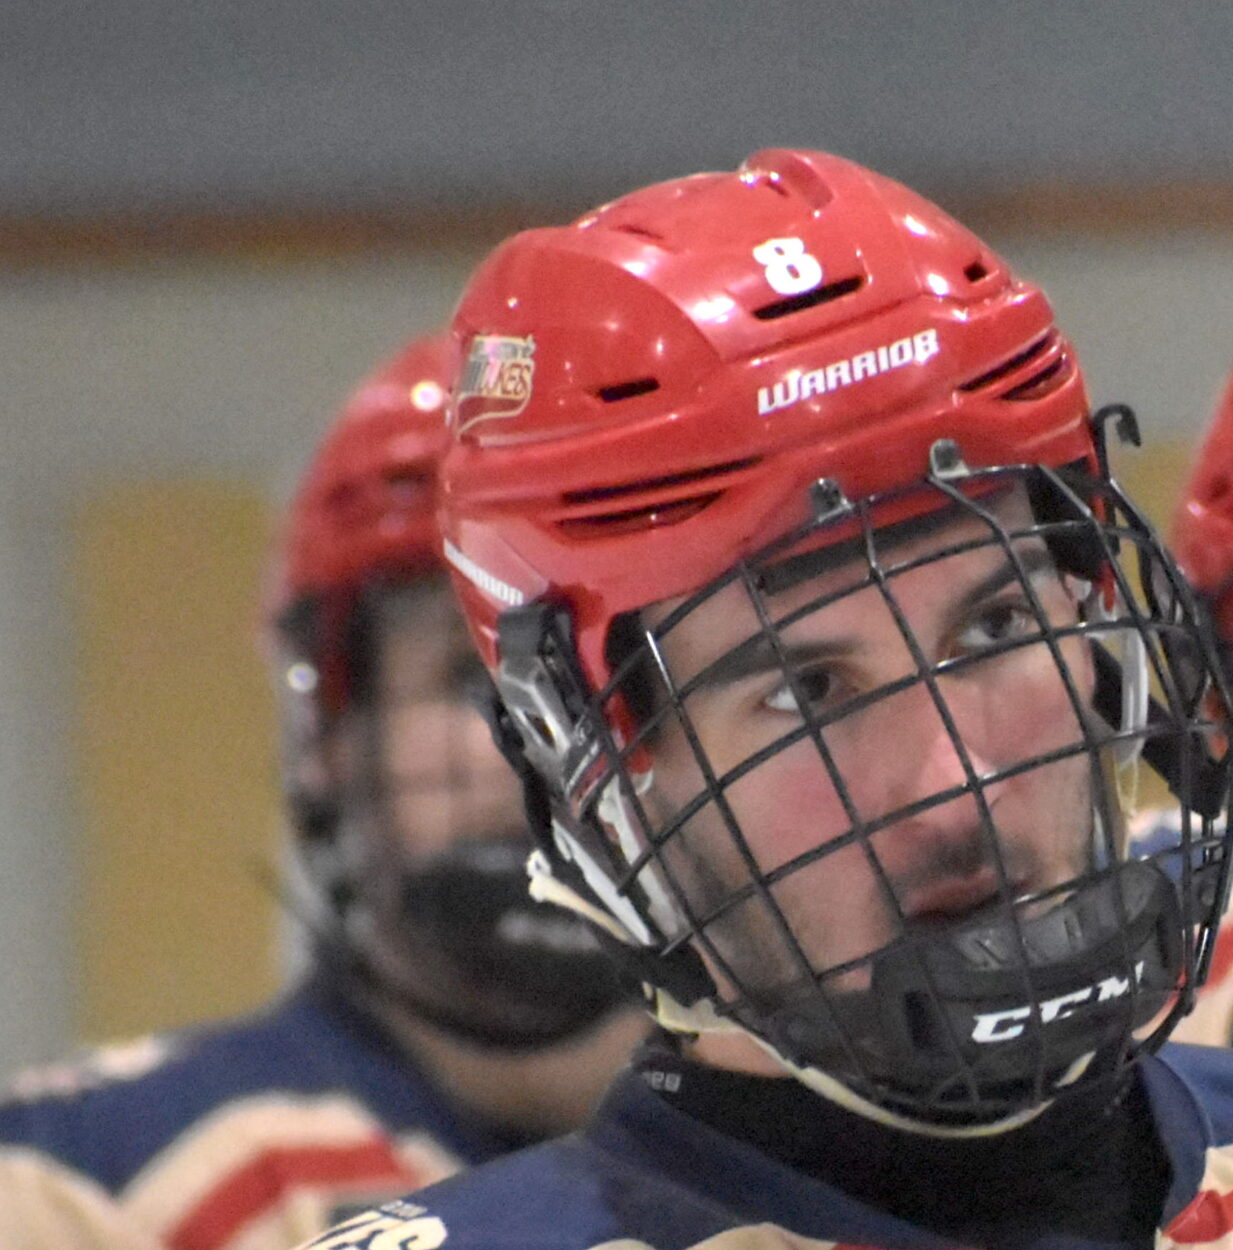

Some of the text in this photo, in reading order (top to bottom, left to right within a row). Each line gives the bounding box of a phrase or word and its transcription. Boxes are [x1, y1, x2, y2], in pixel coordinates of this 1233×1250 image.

[753, 237, 823, 296] 8
[757, 328, 940, 415] WARRIOR
[971, 961, 1144, 1043] CCM
